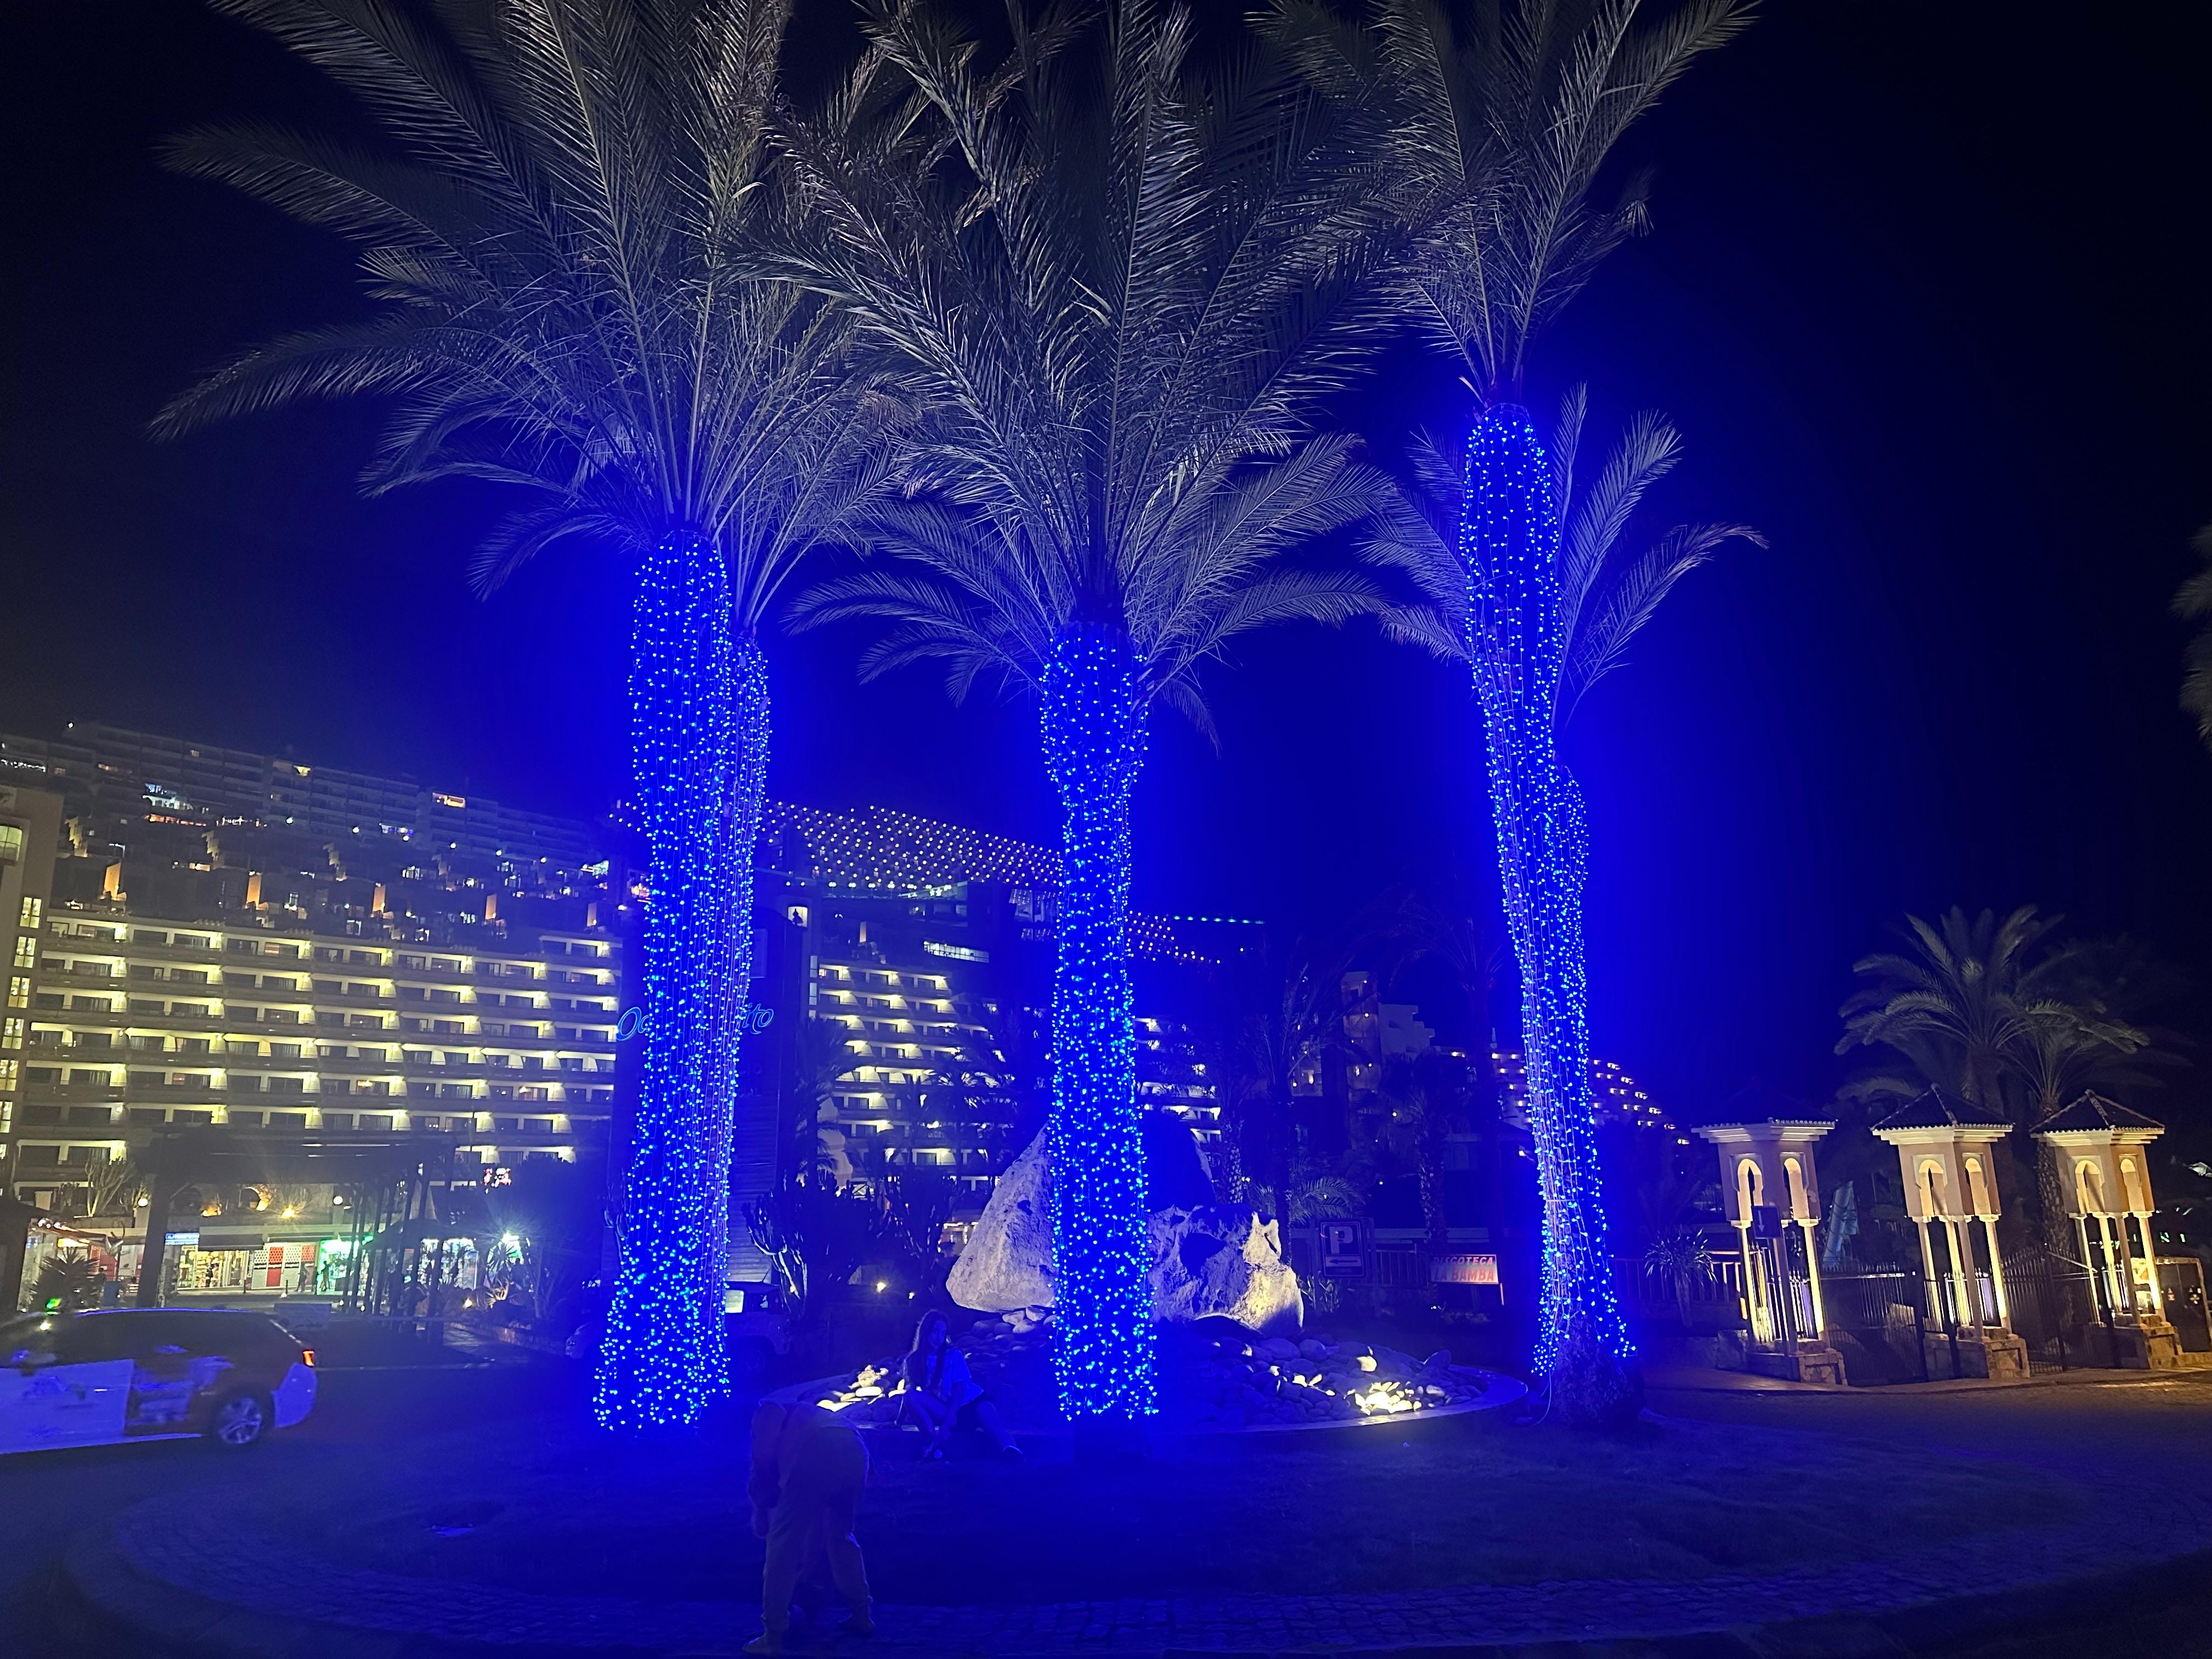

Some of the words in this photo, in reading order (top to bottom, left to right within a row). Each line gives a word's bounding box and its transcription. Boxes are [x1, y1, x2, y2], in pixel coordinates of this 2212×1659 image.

[1329, 1226, 1353, 1254] P
[1433, 1256, 1493, 1266] DISCOTECA
[1435, 1267, 1447, 1281] LA
[1451, 1267, 1494, 1282] BAMBA
